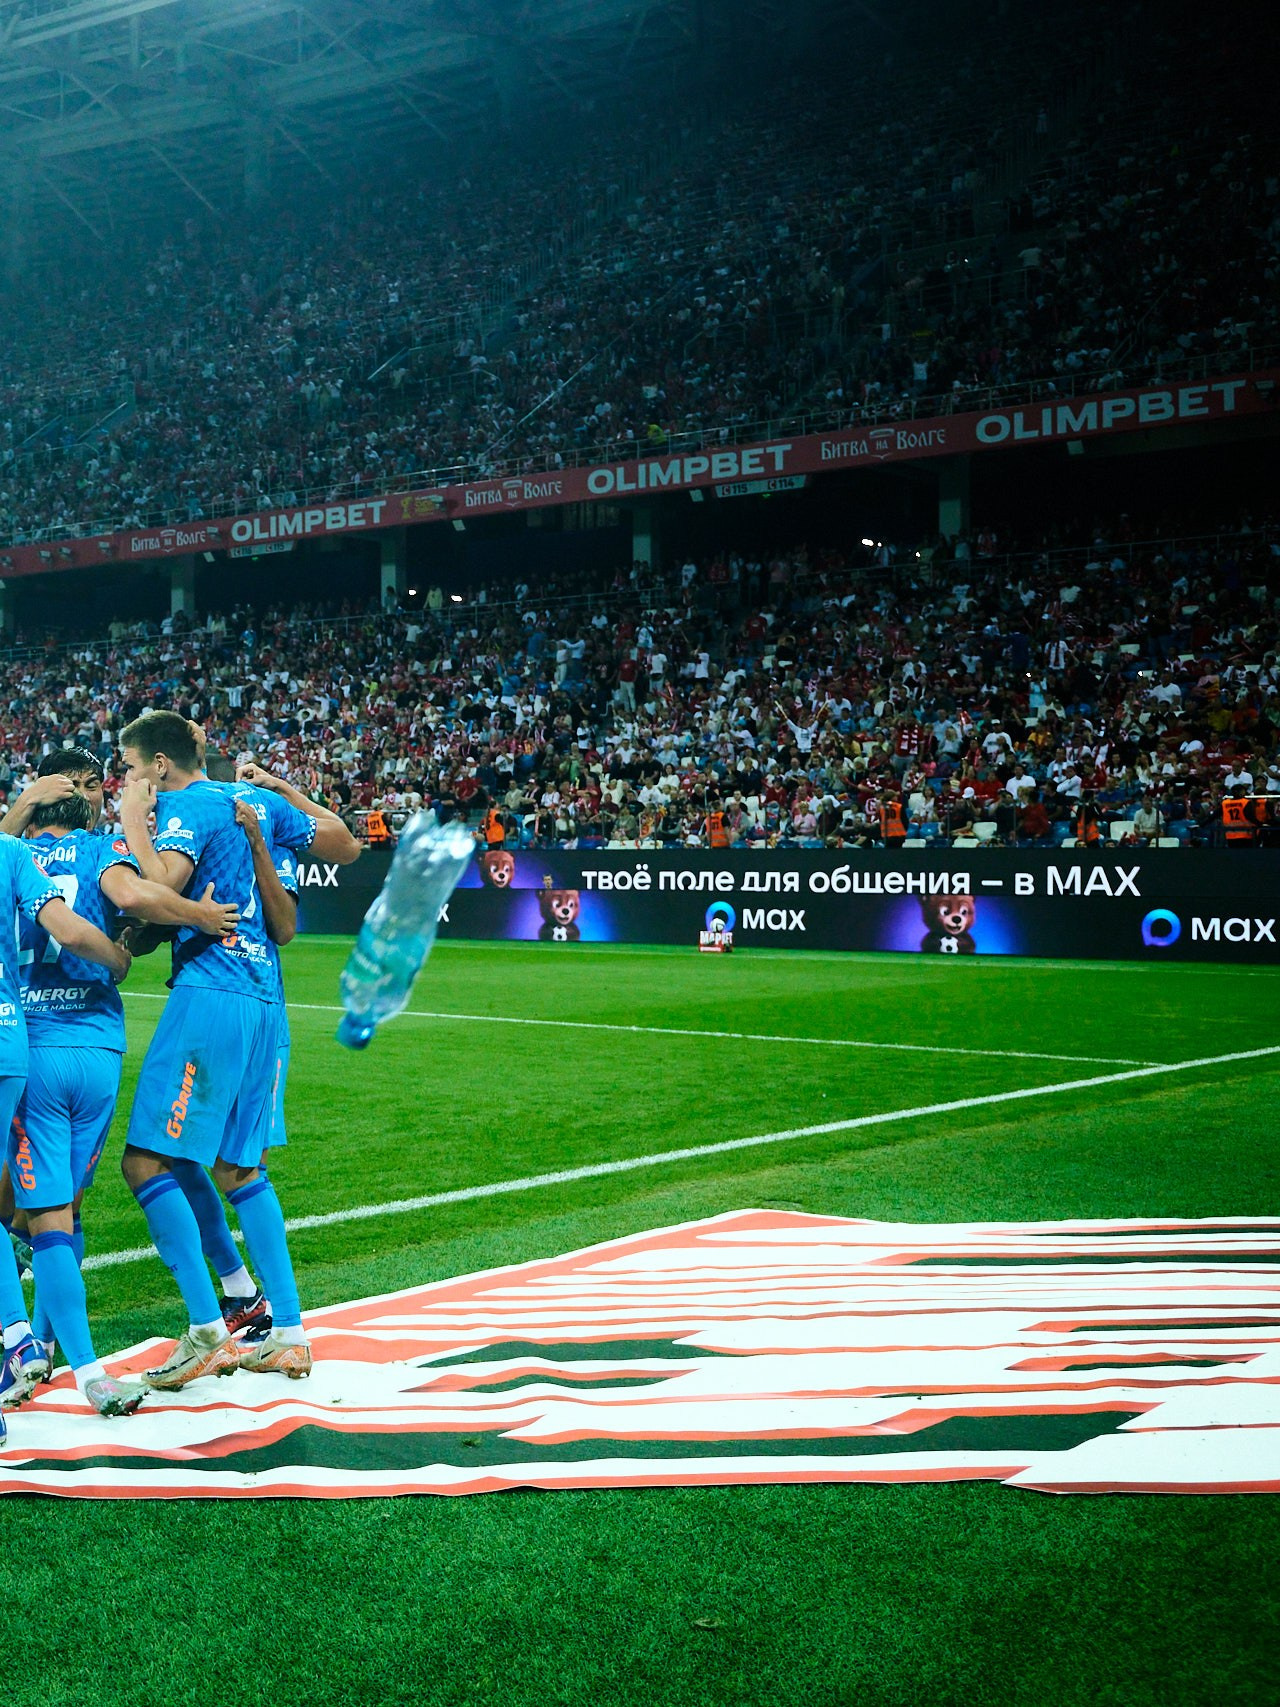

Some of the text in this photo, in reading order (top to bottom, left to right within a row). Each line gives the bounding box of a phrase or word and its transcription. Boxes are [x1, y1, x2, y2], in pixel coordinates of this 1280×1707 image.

[975, 379, 1246, 444] OLIMPBET
[587, 444, 792, 495] OLIMPBET
[231, 500, 387, 542] OLIMPBET
[582, 864, 652, 891] твоё
[658, 870, 734, 892] поле
[740, 870, 800, 893] для
[808, 864, 970, 895] общения
[1014, 872, 1035, 895] в
